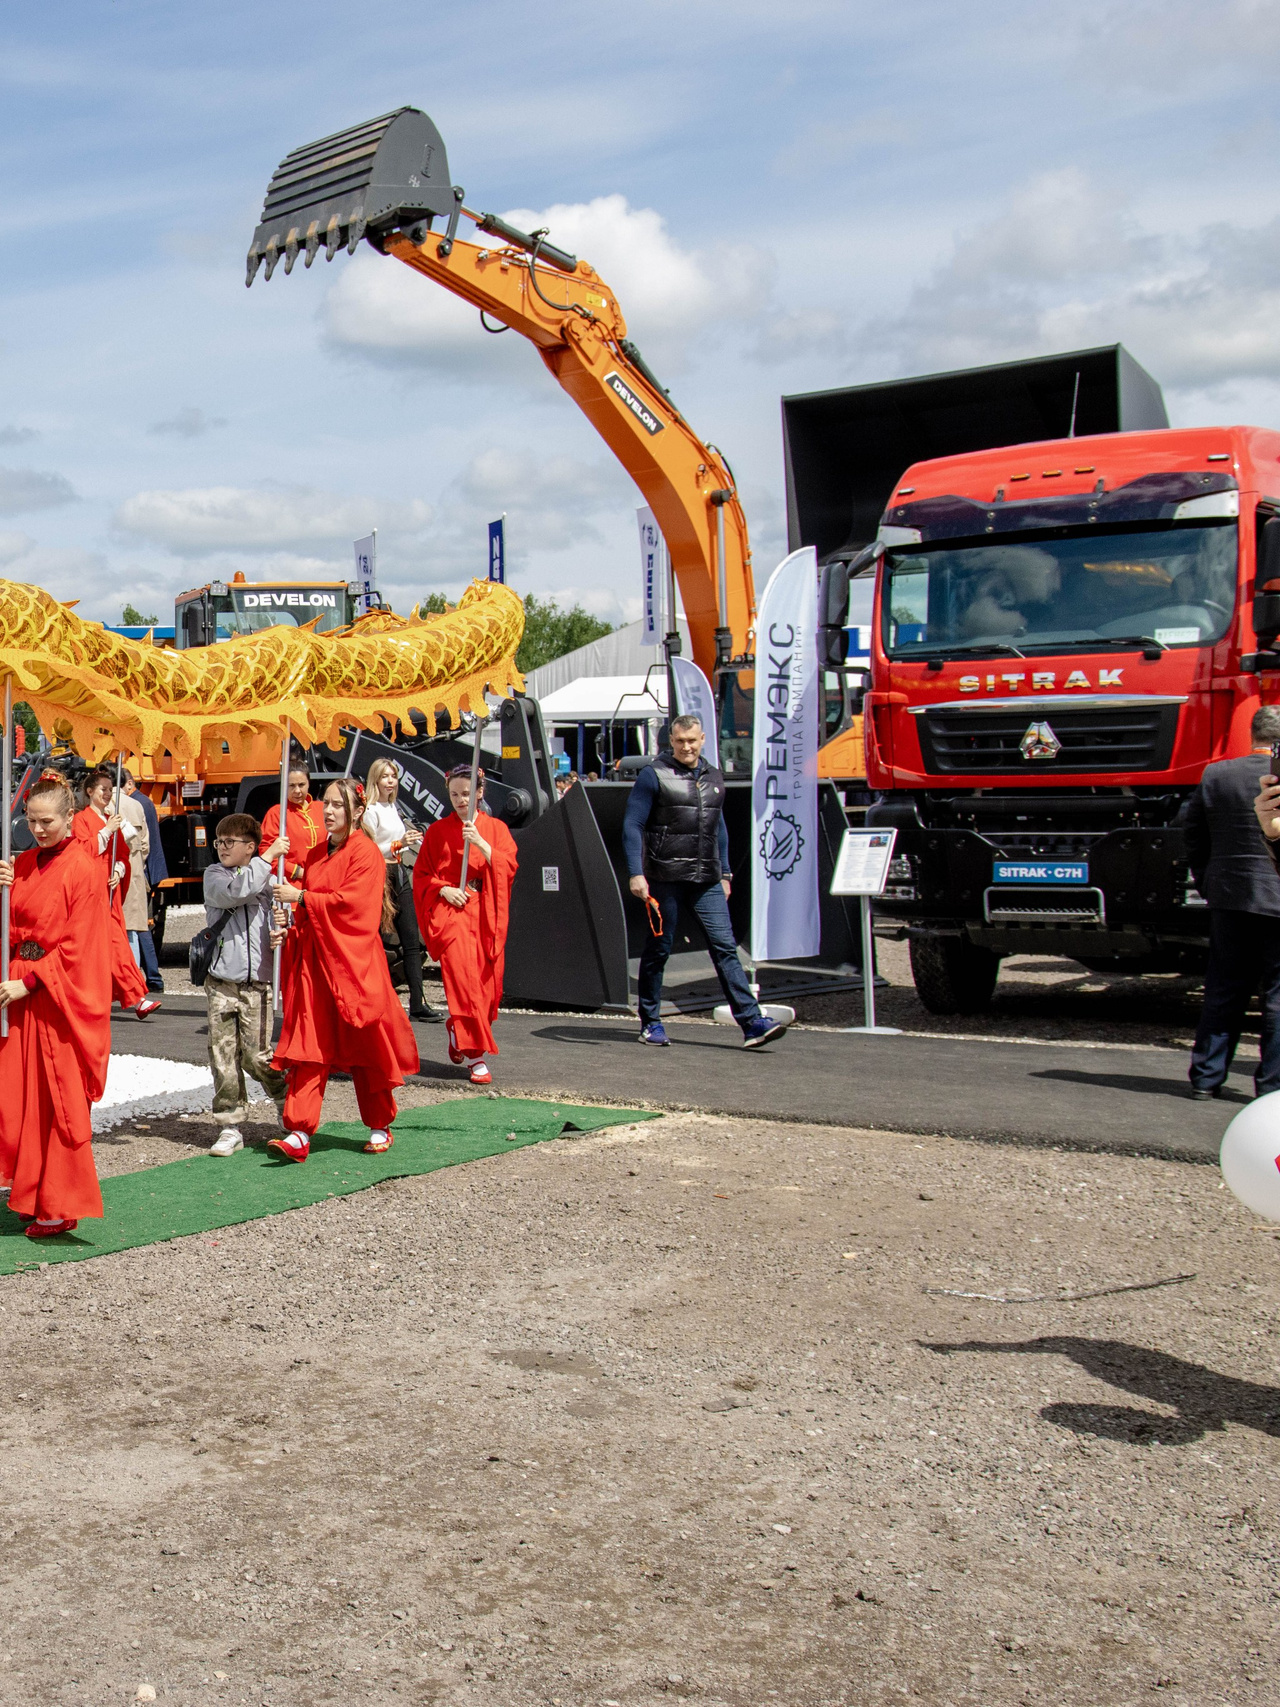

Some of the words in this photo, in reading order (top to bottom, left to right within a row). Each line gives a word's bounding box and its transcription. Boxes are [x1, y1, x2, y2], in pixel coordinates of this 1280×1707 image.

[612, 379, 657, 432] DEVELON
[243, 593, 337, 608] DEVELON
[959, 668, 1125, 693] SITRAK
[765, 622, 796, 800] РЕМЭКС
[392, 759, 445, 820] DEVEL
[792, 730, 804, 799] ГРУППА
